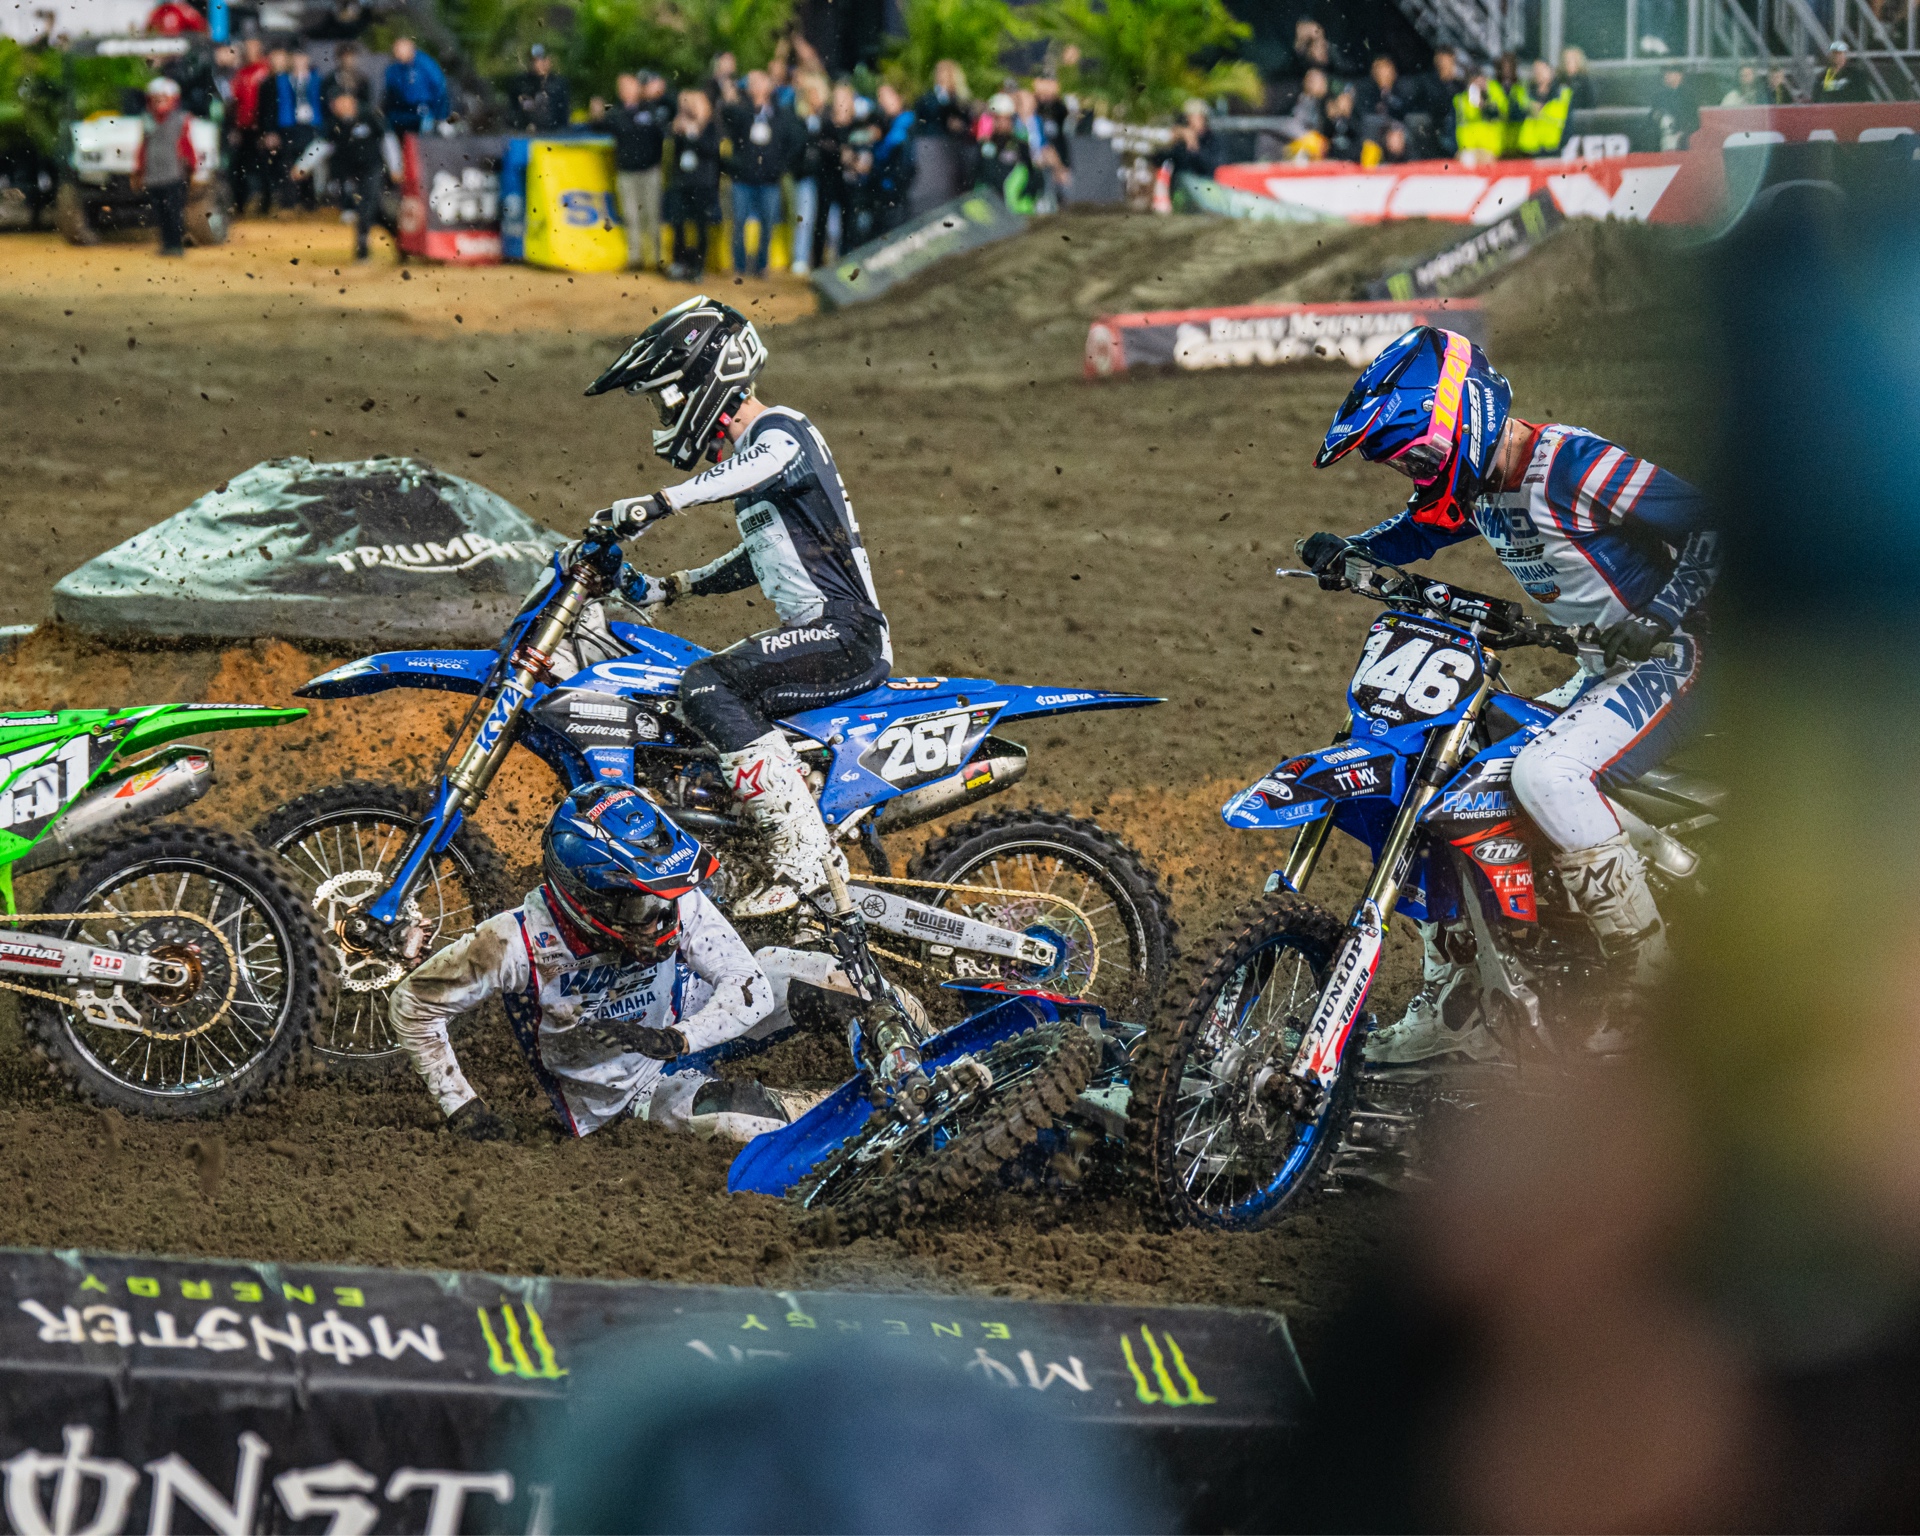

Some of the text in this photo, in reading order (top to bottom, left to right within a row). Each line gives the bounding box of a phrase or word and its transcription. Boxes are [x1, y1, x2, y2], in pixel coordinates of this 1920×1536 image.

[1483, 387, 1494, 423] YAMAHA
[326, 532, 523, 573] TRIUMPH
[1352, 630, 1475, 715] 146
[1045, 693, 1094, 705] DUBYA
[0, 714, 58, 728] Kawasaki
[1370, 704, 1402, 721] dirtlab
[565, 723, 633, 738] FASTHOUSE
[877, 713, 971, 782] 267
[1442, 790, 1514, 812] FAMIL
[1453, 809, 1517, 820] POWERSPORTS
[664, 847, 694, 868] YAMAHA
[0, 943, 63, 961] ENTHAL
[1314, 937, 1363, 1037] DUNLOP
[1341, 966, 1371, 1024] TAMER
[80, 1274, 365, 1308] ENERGY
